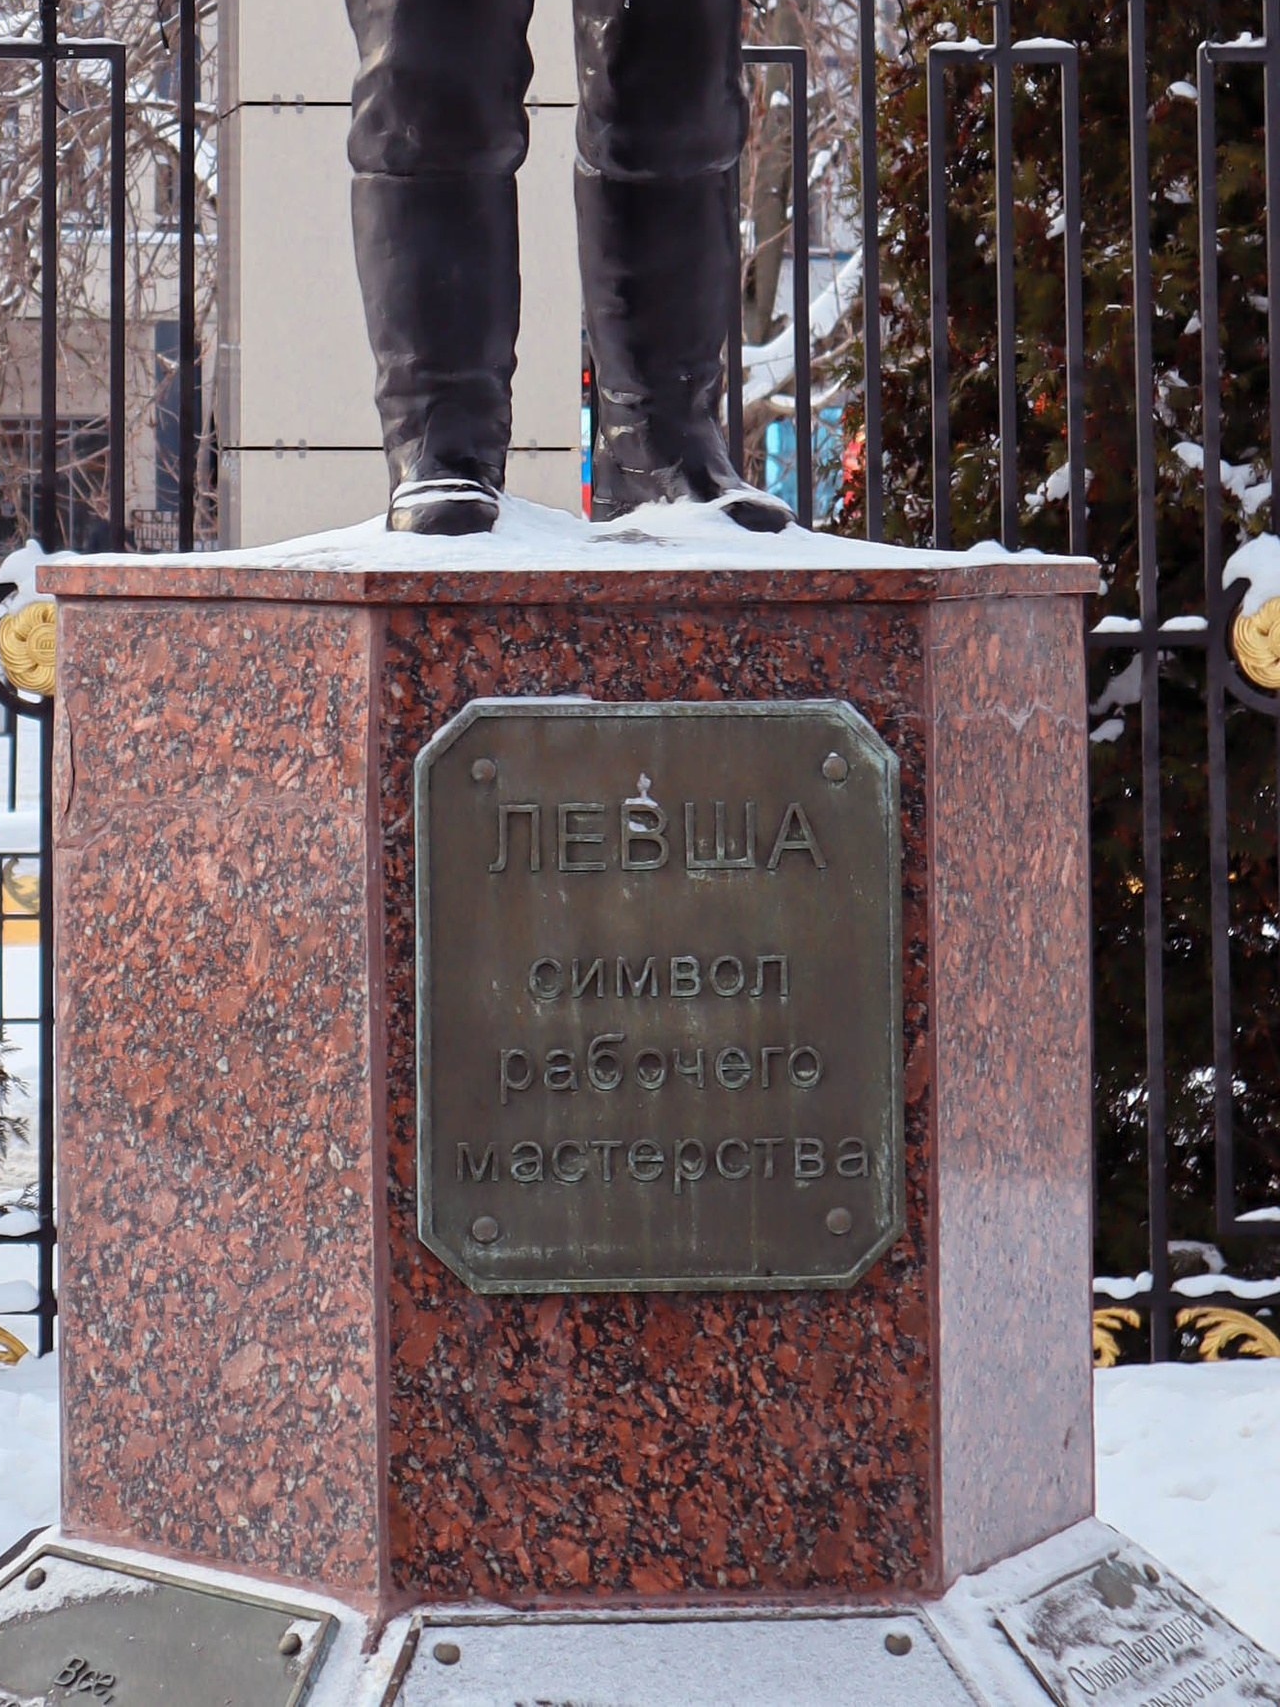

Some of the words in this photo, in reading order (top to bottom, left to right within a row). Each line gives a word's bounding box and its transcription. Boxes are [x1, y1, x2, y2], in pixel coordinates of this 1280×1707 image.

[488, 800, 826, 873] ЛЕВША
[528, 953, 790, 1000] символ
[498, 1032, 823, 1105] рабочего
[455, 1135, 873, 1194] мастерства
